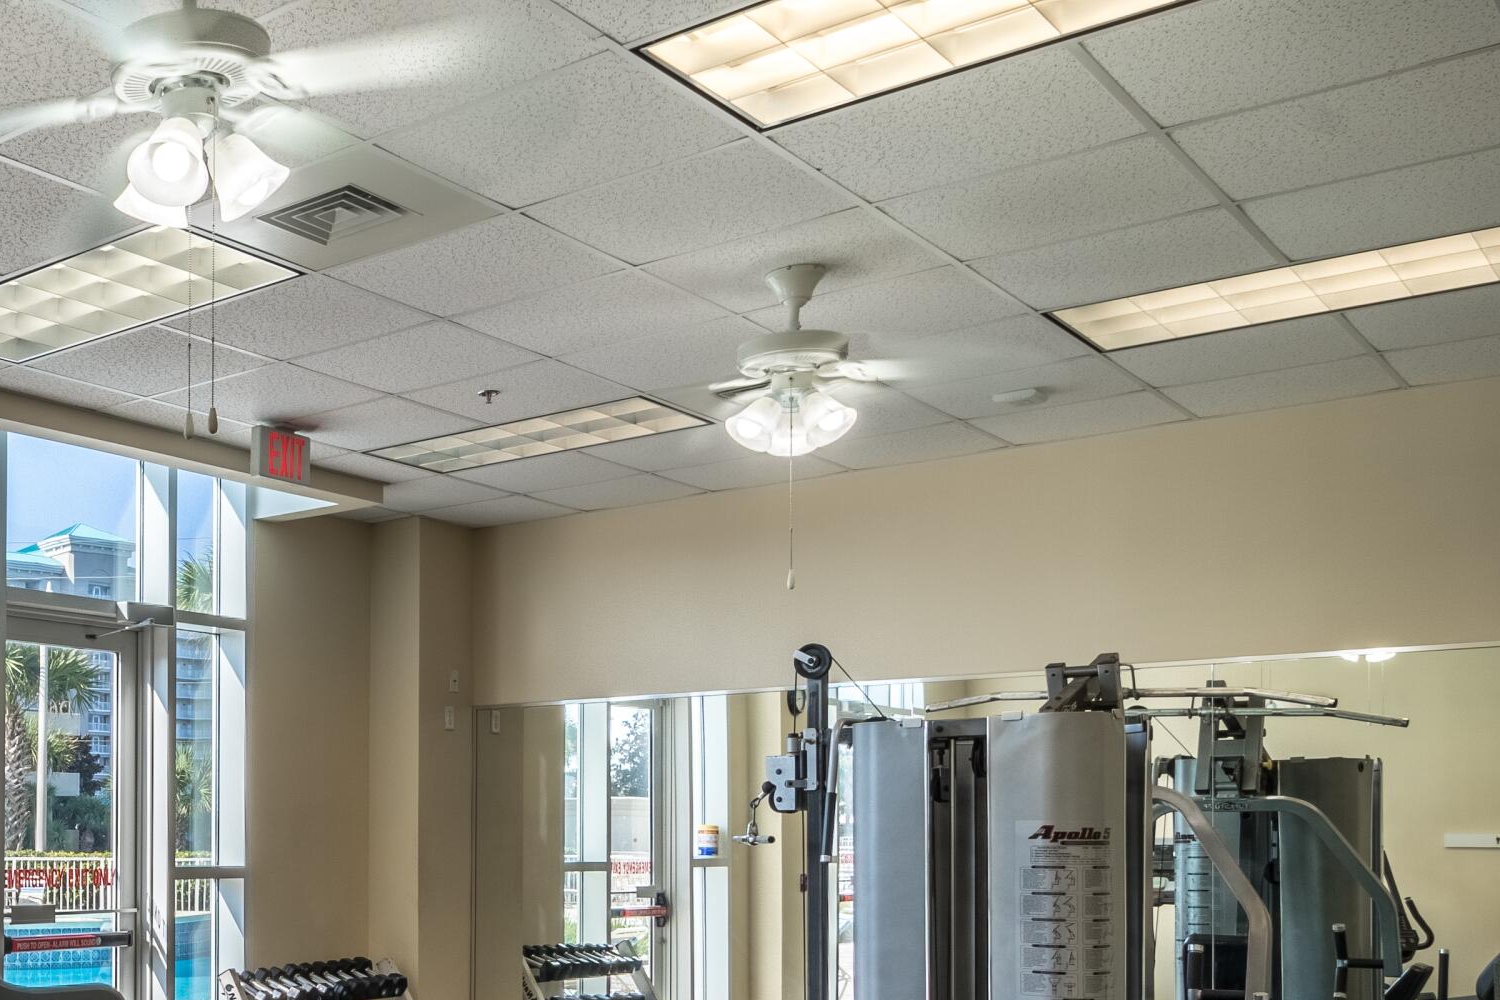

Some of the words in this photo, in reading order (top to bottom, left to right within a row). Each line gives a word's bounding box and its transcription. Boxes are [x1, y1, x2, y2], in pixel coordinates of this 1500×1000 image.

[268, 431, 306, 481] EXIT
[1028, 824, 1102, 843] Apollo
[1102, 827, 1111, 840] 5
[4, 868, 63, 889] EMERGENCY
[68, 868, 89, 888] EXIT
[93, 866, 116, 887] ONLY
[16, 942, 30, 951] PUSH
[30, 942, 37, 950] TO
[69, 939, 80, 947] WILL
